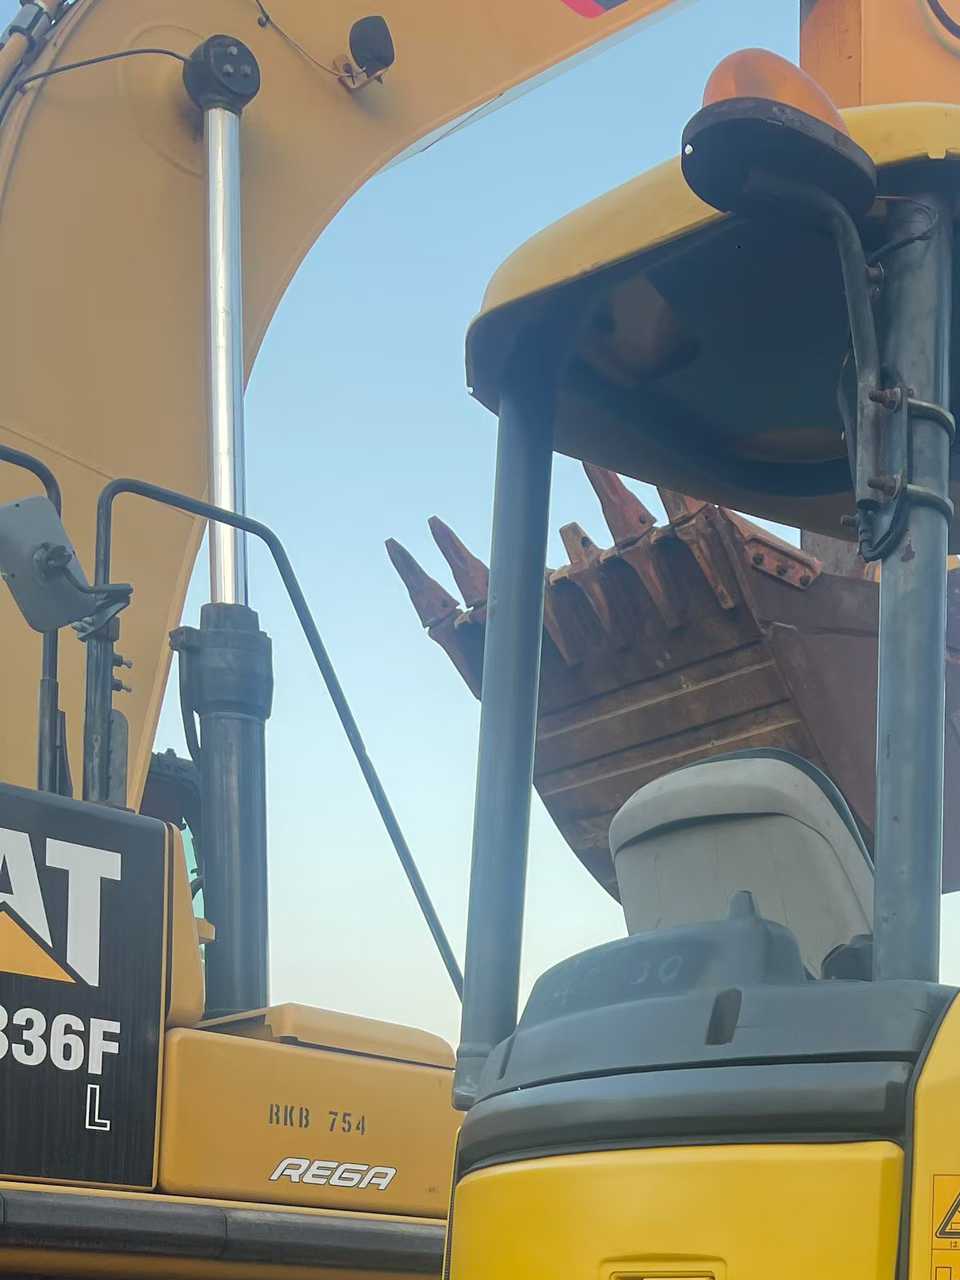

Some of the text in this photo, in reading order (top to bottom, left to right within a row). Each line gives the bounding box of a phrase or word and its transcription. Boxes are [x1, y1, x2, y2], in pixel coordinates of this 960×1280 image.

[0, 1004, 121, 1075] 36F
[85, 1084, 111, 1131] L
[329, 1111, 366, 1135] 754
[268, 1157, 397, 1190] REGA
